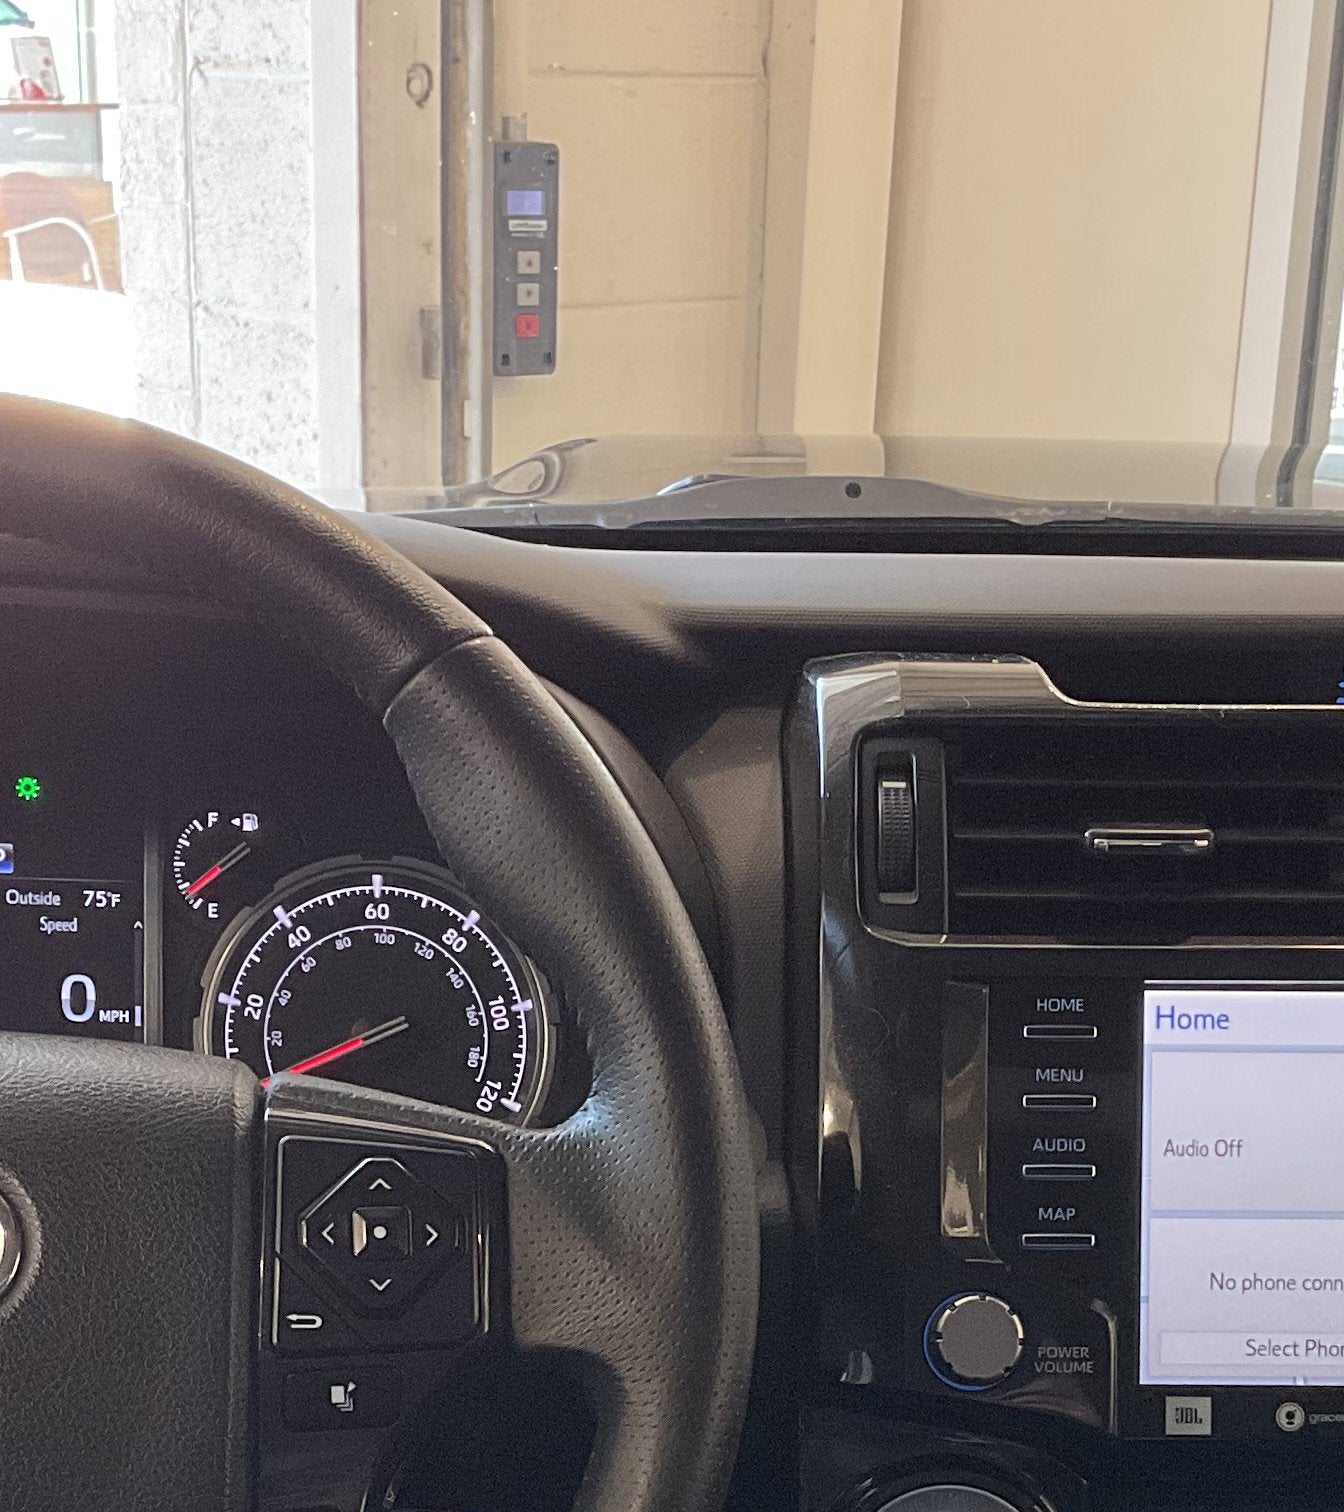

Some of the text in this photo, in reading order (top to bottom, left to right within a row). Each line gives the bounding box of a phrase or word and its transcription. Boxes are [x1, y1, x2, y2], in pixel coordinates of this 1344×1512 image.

[208, 812, 219, 828] F
[6, 889, 61, 906] Outside
[208, 903, 218, 919] E
[365, 903, 390, 921] 60
[39, 916, 78, 935] Speed
[287, 924, 313, 949] 40
[335, 936, 352, 951] 80
[374, 932, 396, 947] 100
[441, 928, 468, 953] 80
[413, 942, 435, 961] 120
[301, 956, 318, 973] 60
[445, 967, 465, 990] 140
[60, 973, 130, 1024] 0 MPH
[244, 993, 265, 1021] 20
[278, 989, 292, 1007] 40
[1036, 998, 1085, 1013] HOME
[464, 1004, 480, 1027] 160
[488, 995, 510, 1032] 100
[1155, 1005, 1231, 1030] Home
[271, 1030, 283, 1047] 20
[467, 1045, 481, 1068] 180
[1035, 1068, 1085, 1083] MENU
[476, 1080, 502, 1113] 120
[1032, 1138, 1086, 1153] AUDIO
[1163, 1139, 1244, 1158] Audio Off
[1038, 1207, 1077, 1222] MAP
[1209, 1272, 1237, 1291] No
[1241, 1272, 1297, 1295] phone
[1037, 1346, 1090, 1360] POWER
[1245, 1338, 1300, 1357] Select
[1034, 1360, 1094, 1374] VOLUME
[1175, 1407, 1203, 1425] JBL
